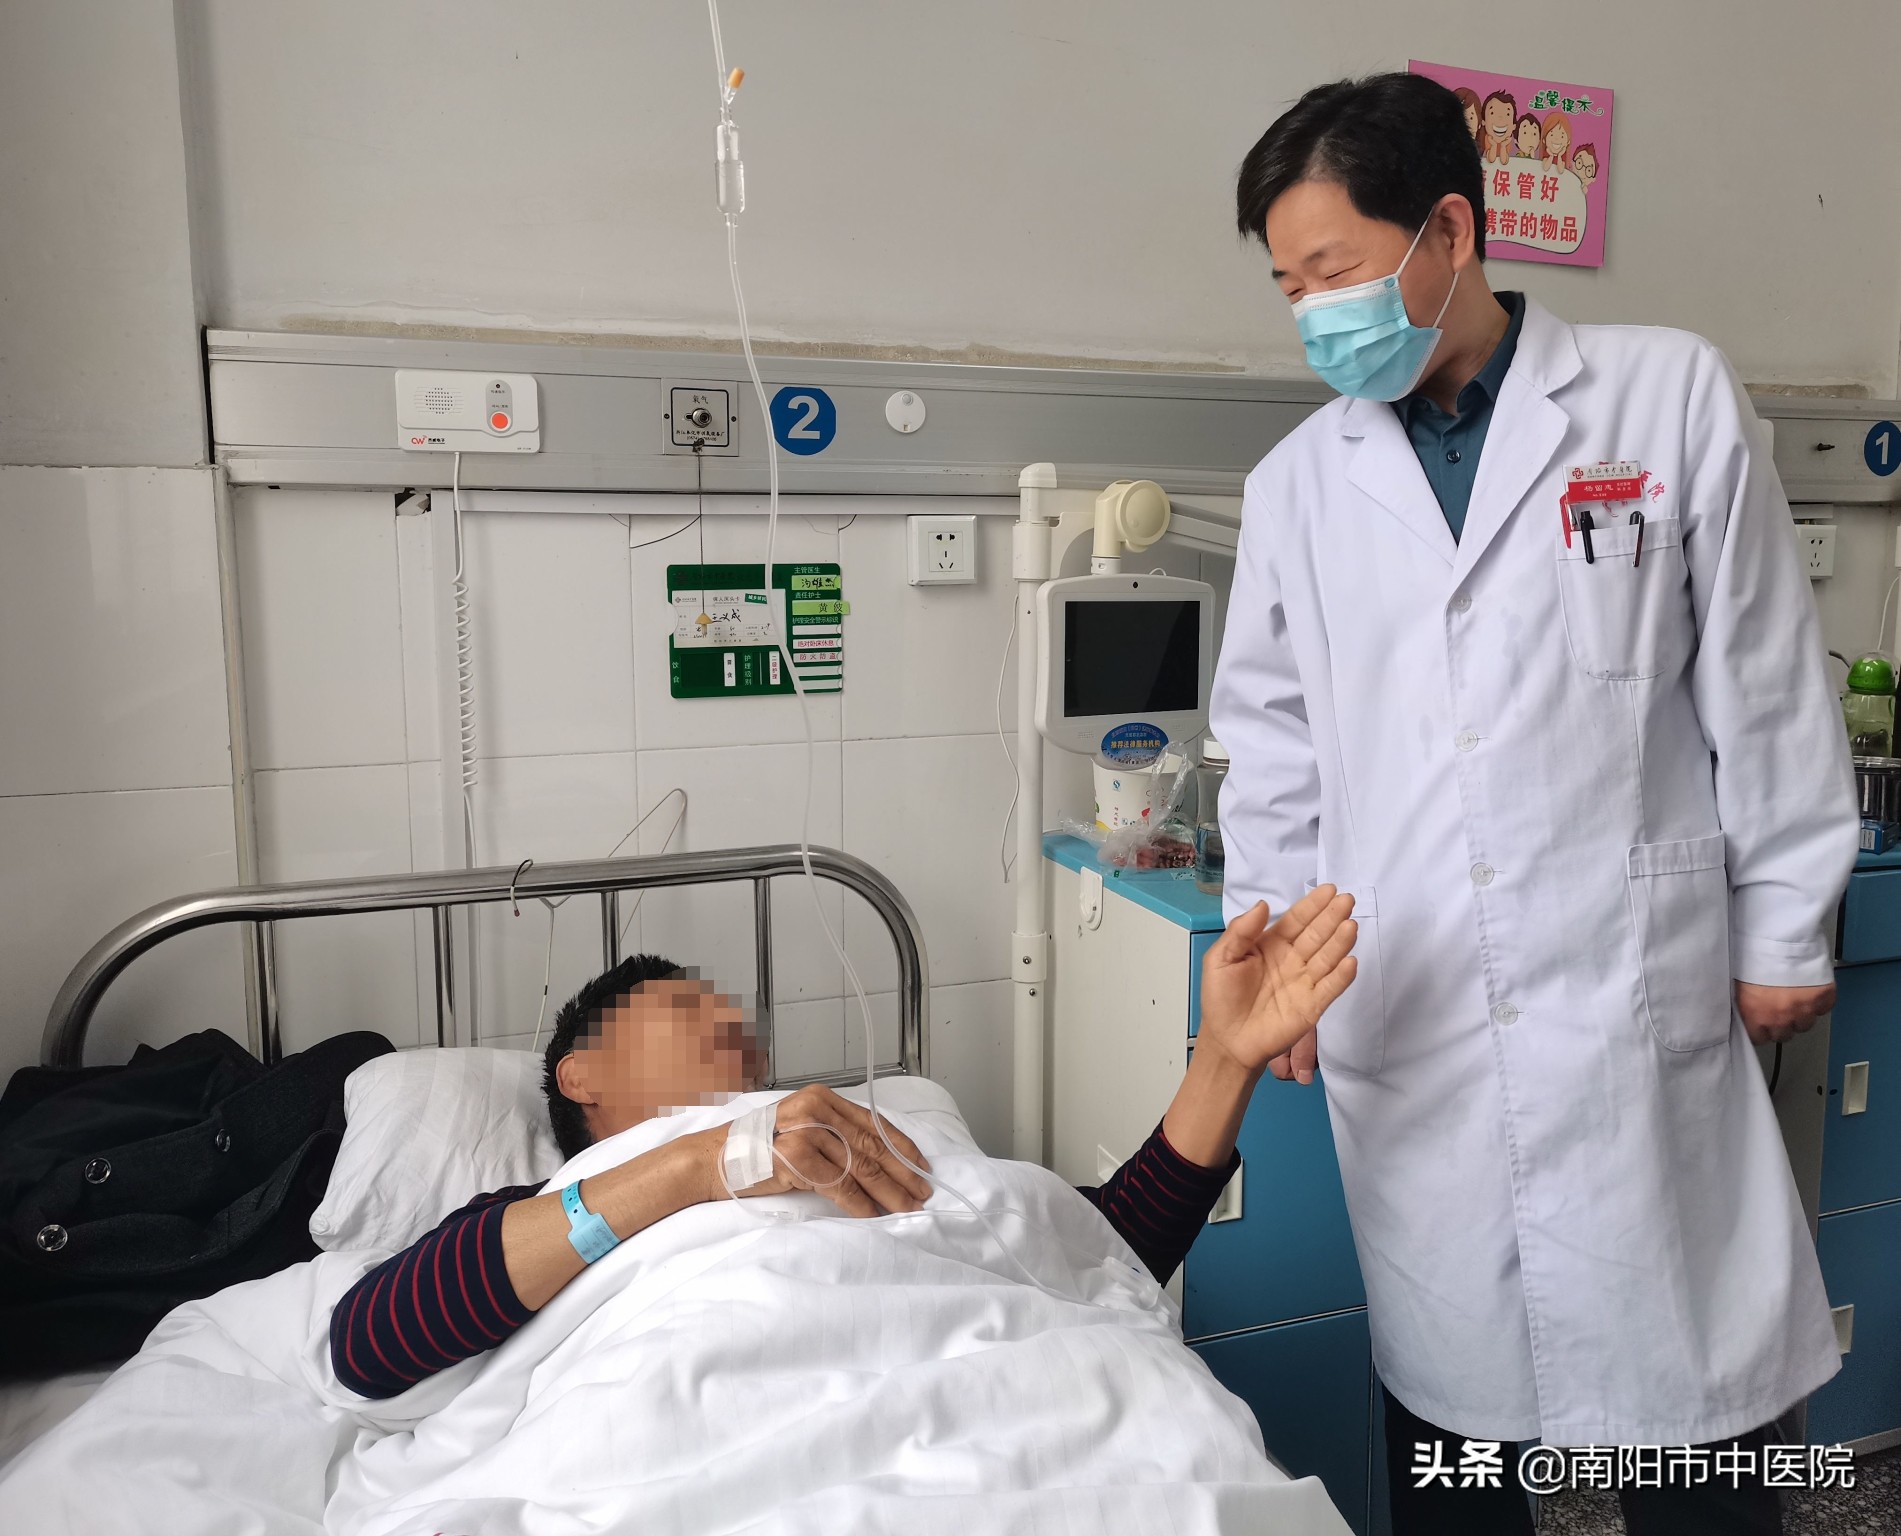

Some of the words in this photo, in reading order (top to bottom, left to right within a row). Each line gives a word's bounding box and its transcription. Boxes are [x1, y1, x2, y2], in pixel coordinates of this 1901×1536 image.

[788, 395, 821, 440] 2
[1875, 431, 1890, 465] 1
[794, 566, 821, 574] 主管医生
[795, 591, 821, 599] 责任护士
[792, 616, 839, 624] 护理安全警示标识
[744, 654, 752, 686] 护理级别
